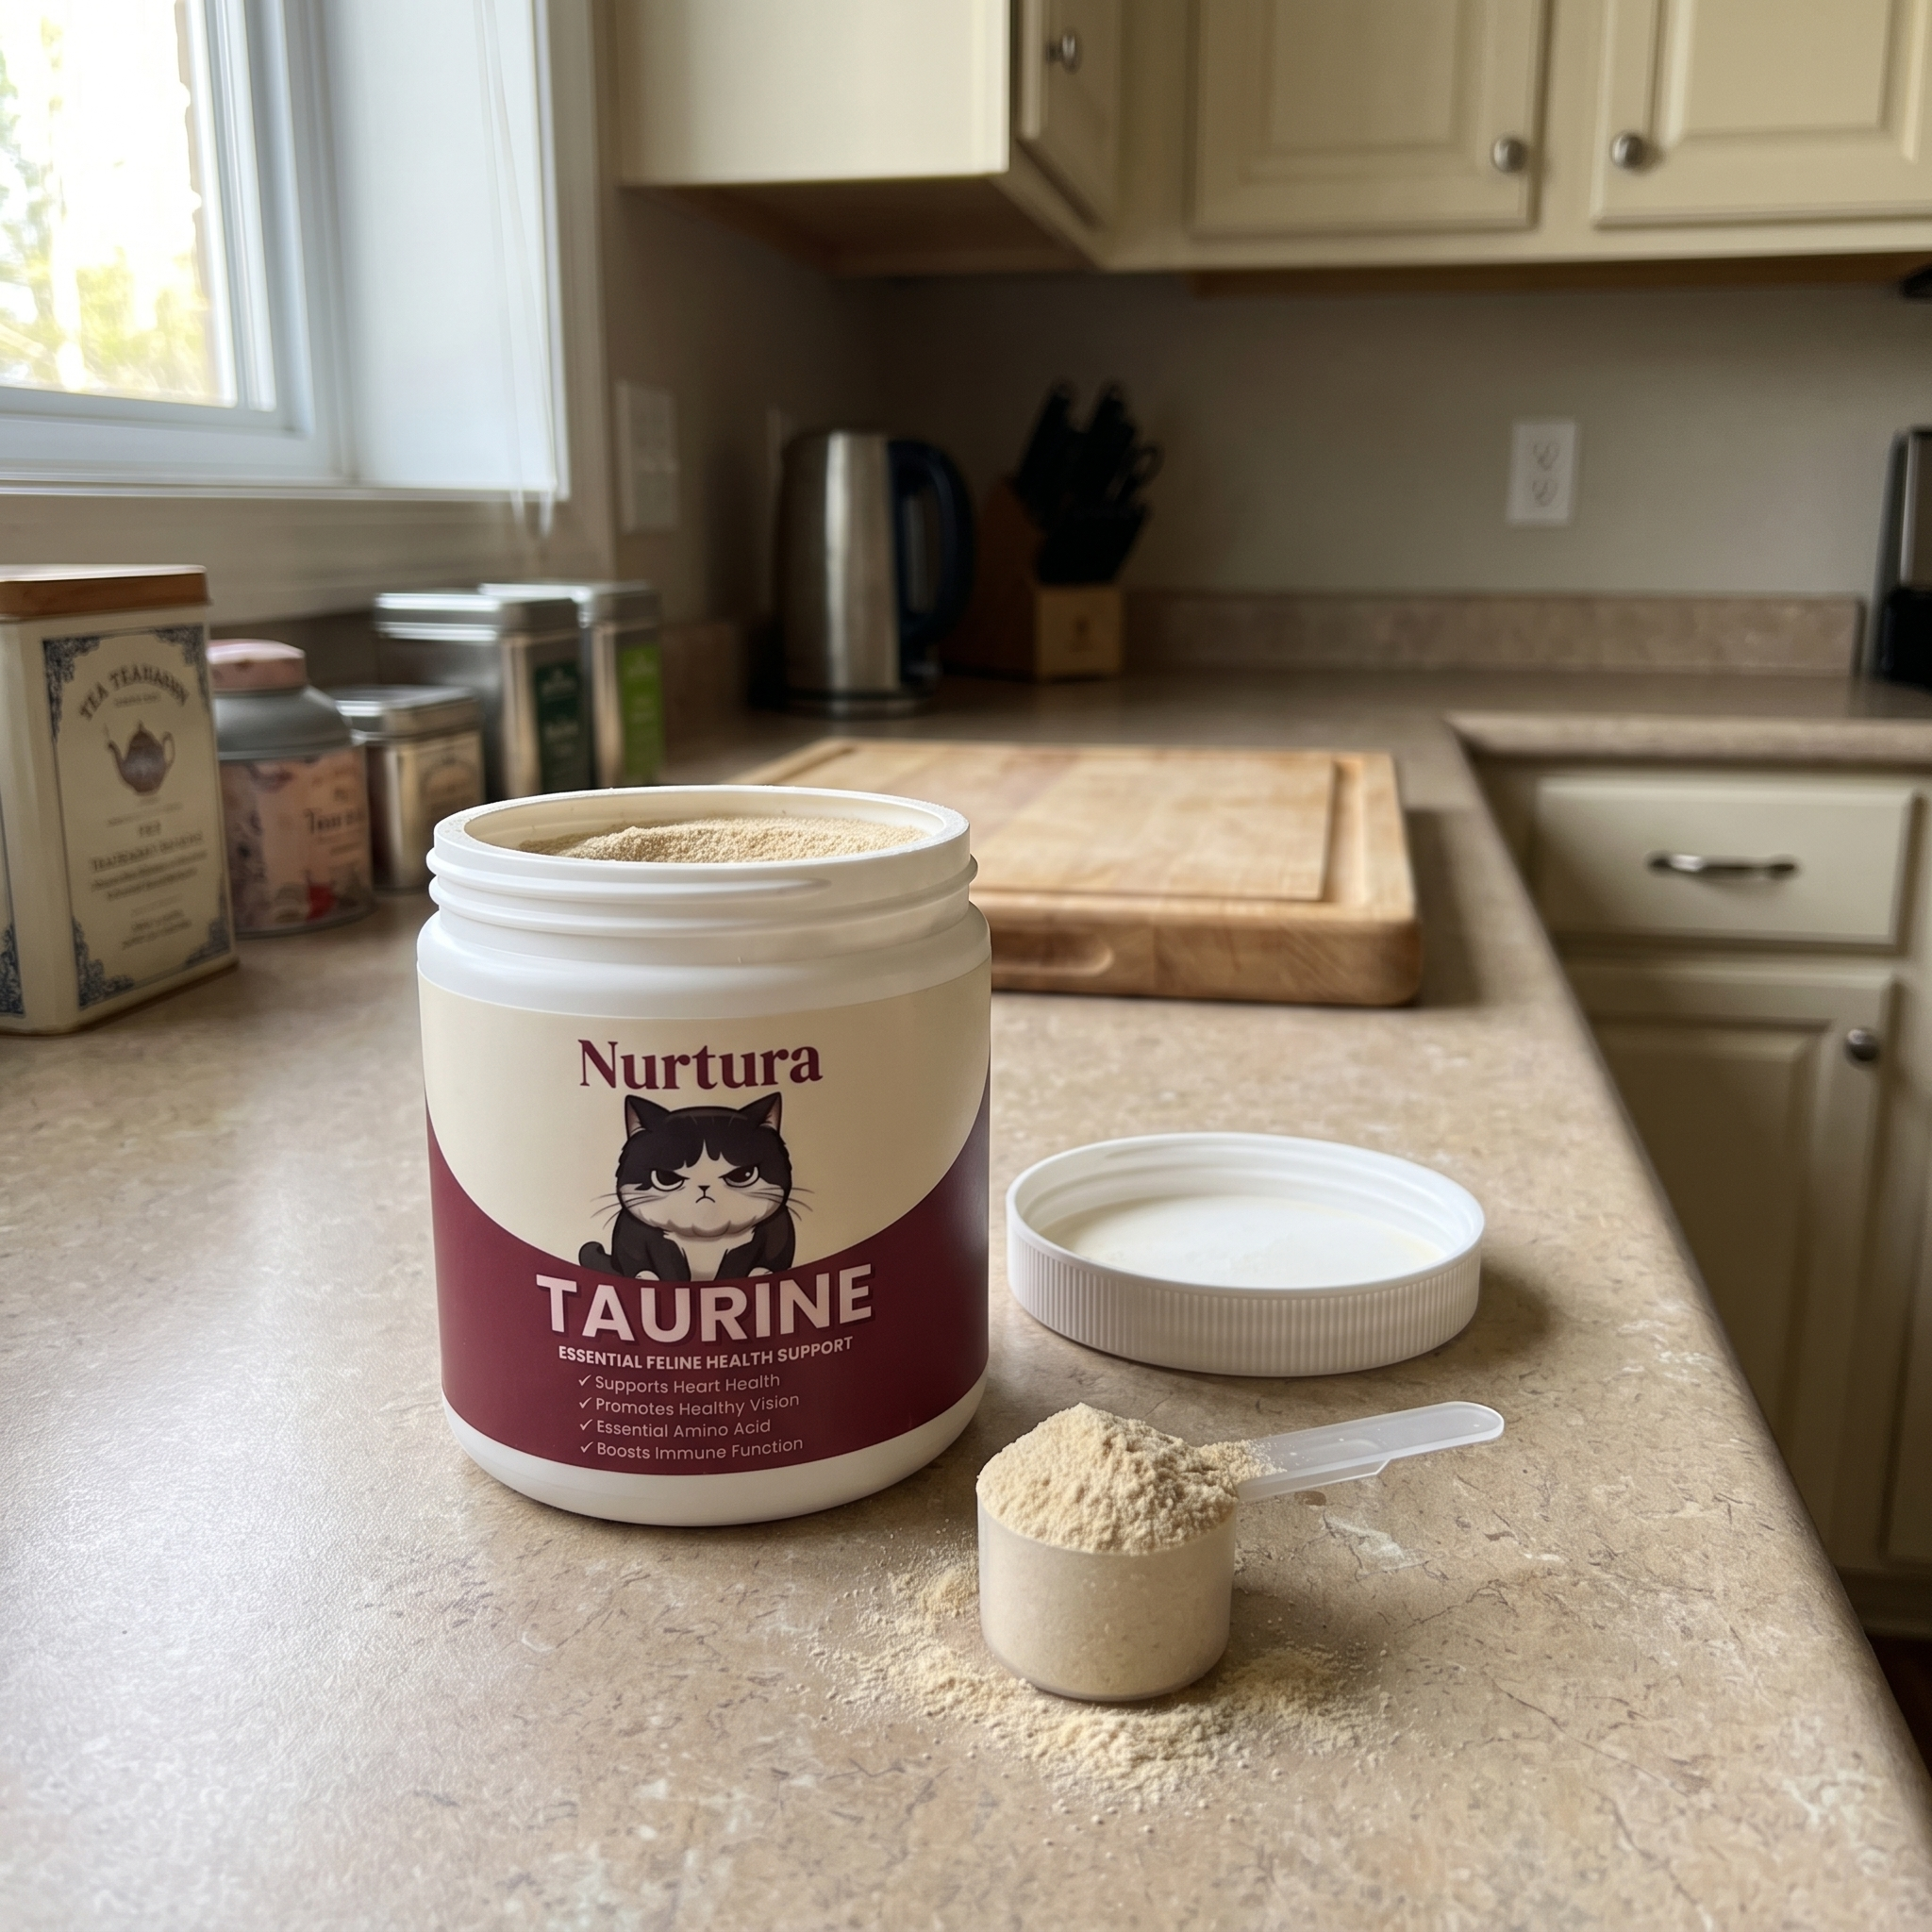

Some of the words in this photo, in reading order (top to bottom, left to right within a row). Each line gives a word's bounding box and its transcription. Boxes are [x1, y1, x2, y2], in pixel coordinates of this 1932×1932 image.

[577, 1039, 824, 1090] Nurtura
[535, 1263, 874, 1343] TAURINE
[558, 1345, 642, 1369] ESSENTIAL
[646, 1356, 702, 1370] FELINE
[706, 1350, 773, 1370] HEALTH
[777, 1336, 853, 1362] SUPPORT
[595, 1375, 669, 1396] Supports
[674, 1379, 721, 1393] Heart
[725, 1374, 780, 1391] Health
[595, 1397, 675, 1416] Promotes
[679, 1400, 745, 1418] Healthy
[749, 1395, 799, 1411] Vision
[596, 1419, 668, 1438] Essential
[673, 1424, 728, 1438] Amino
[733, 1419, 771, 1436] Acid
[597, 1441, 651, 1459] Boosts
[655, 1446, 726, 1460] Immune
[731, 1439, 803, 1458] Function
